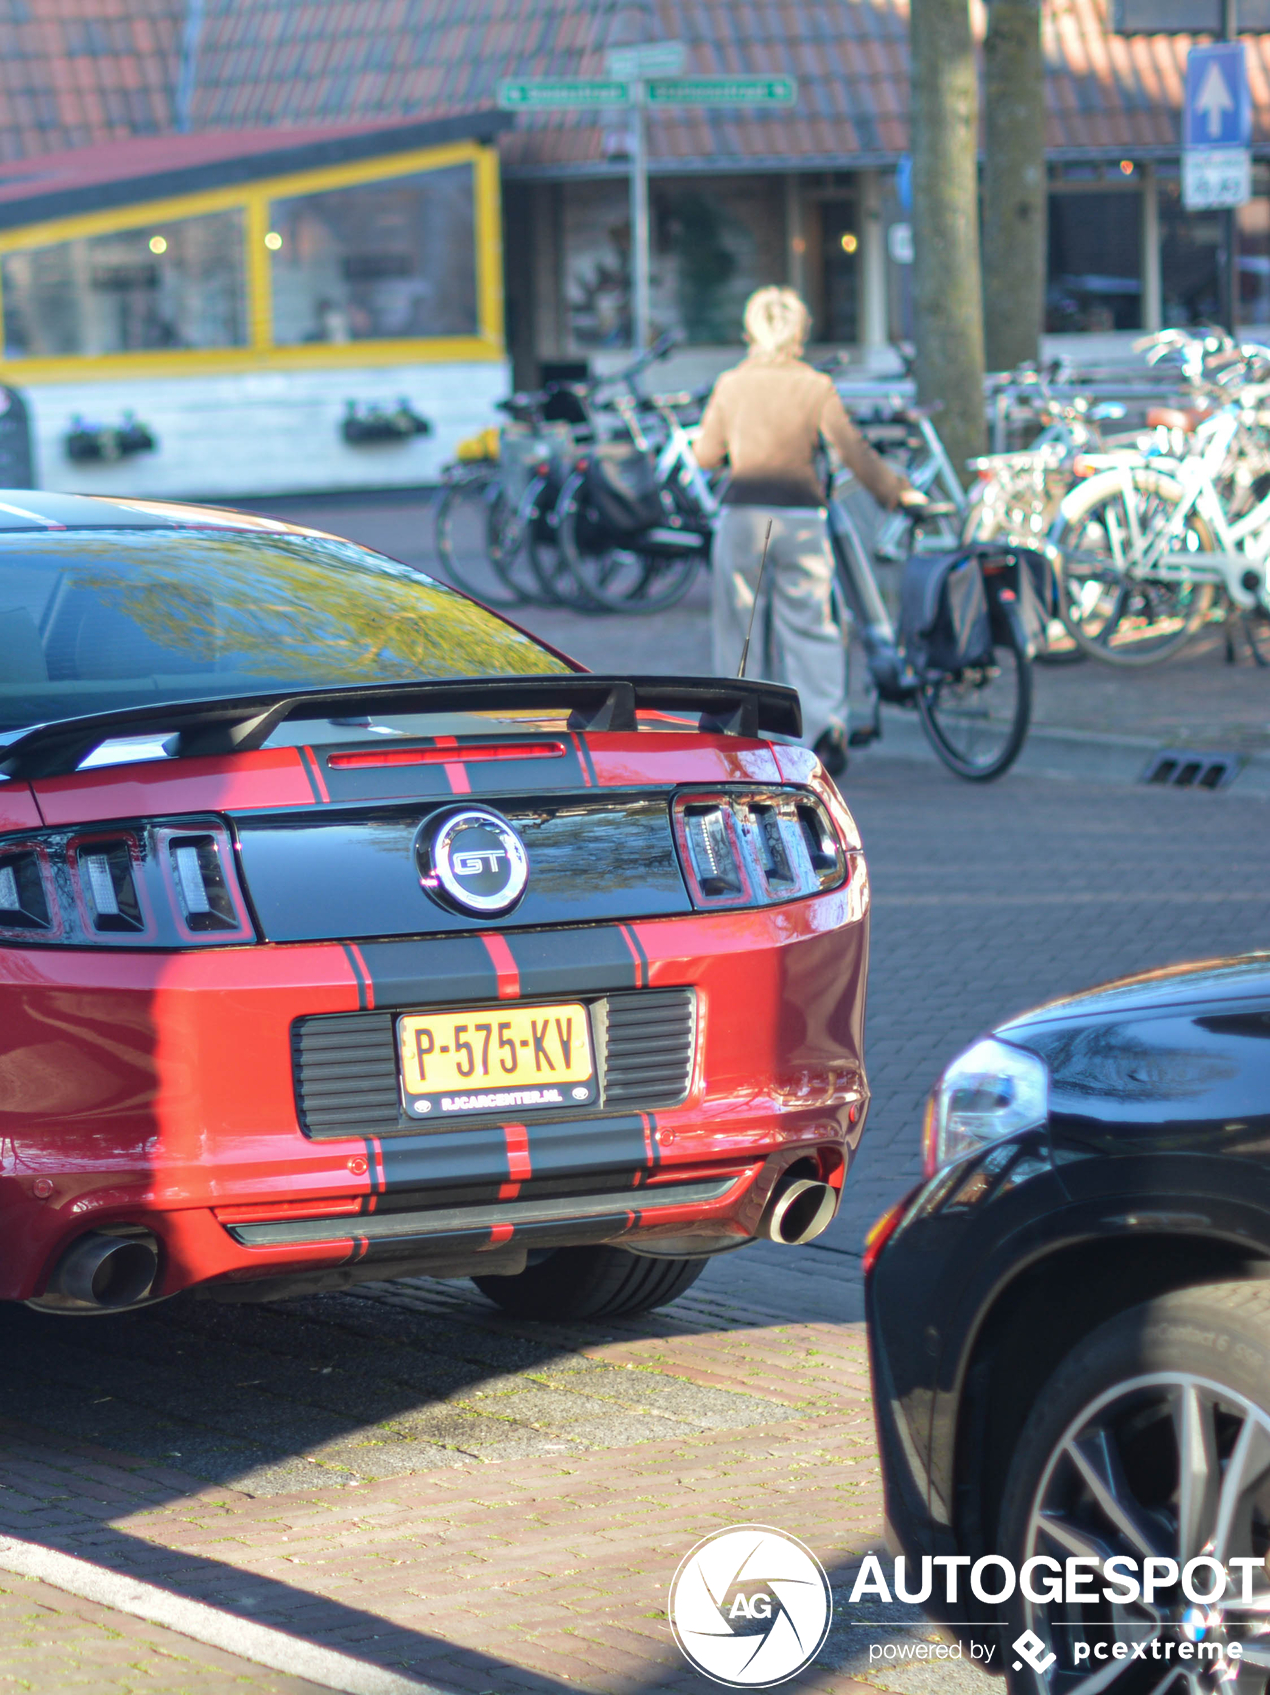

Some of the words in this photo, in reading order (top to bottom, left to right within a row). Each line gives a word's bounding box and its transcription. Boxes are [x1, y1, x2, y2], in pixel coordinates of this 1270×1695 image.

[453, 850, 505, 875] GT
[415, 1018, 572, 1081] P-575-KV
[441, 1089, 563, 1111] RJCARCENTER.NL
